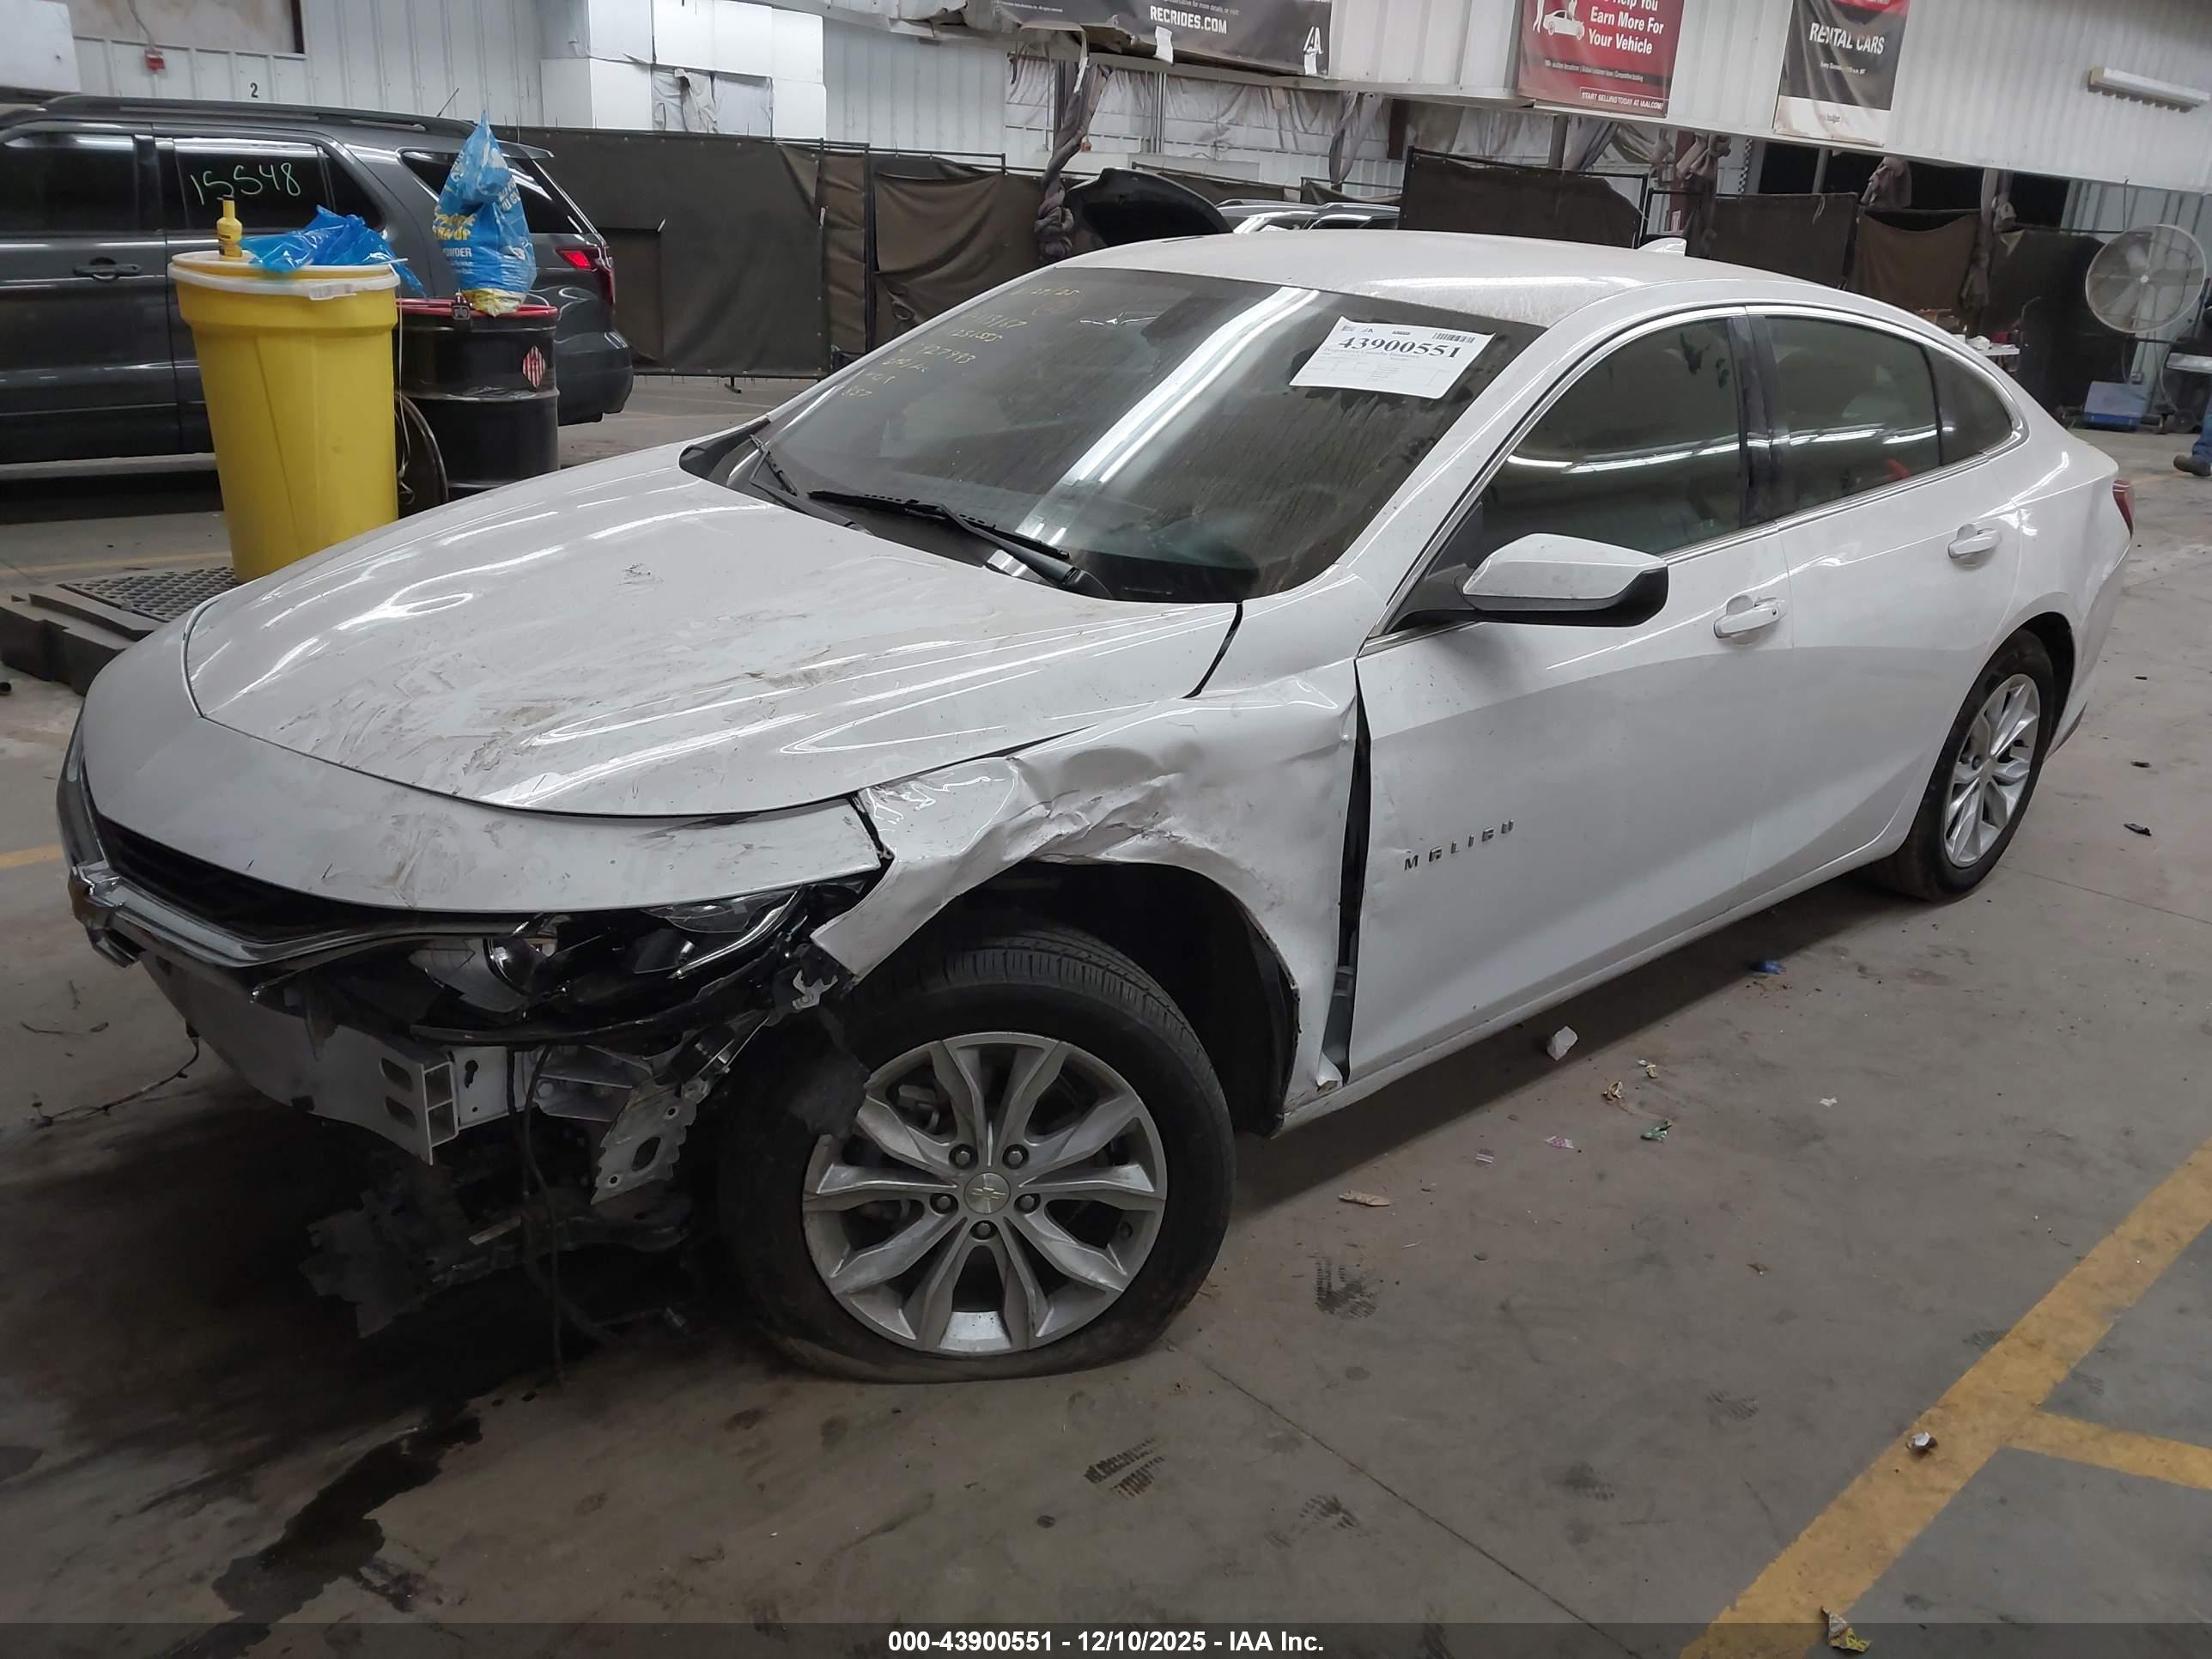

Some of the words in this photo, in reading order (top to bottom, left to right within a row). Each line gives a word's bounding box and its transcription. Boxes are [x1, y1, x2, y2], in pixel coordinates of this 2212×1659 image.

[1641, 0, 1658, 11] You
[1150, 6, 1227, 34] RECRIDES.COM
[1590, 6, 1616, 26] Earn
[1618, 11, 1645, 32] More
[1647, 17, 1664, 35] For
[1588, 28, 1613, 48] Your
[1615, 33, 1653, 55] Vehicle
[1808, 22, 1853, 50] RENTAL
[1856, 34, 1885, 55] CARS
[249, 82, 259, 99] 2
[1582, 92, 1597, 102] START
[1597, 94, 1618, 105] SELLING
[1618, 97, 1633, 106] TODAY
[1633, 99, 1640, 107] AT
[190, 162, 301, 206] 15548
[1338, 336, 1463, 359] 43900551
[1404, 818, 1515, 872] MALIBU
